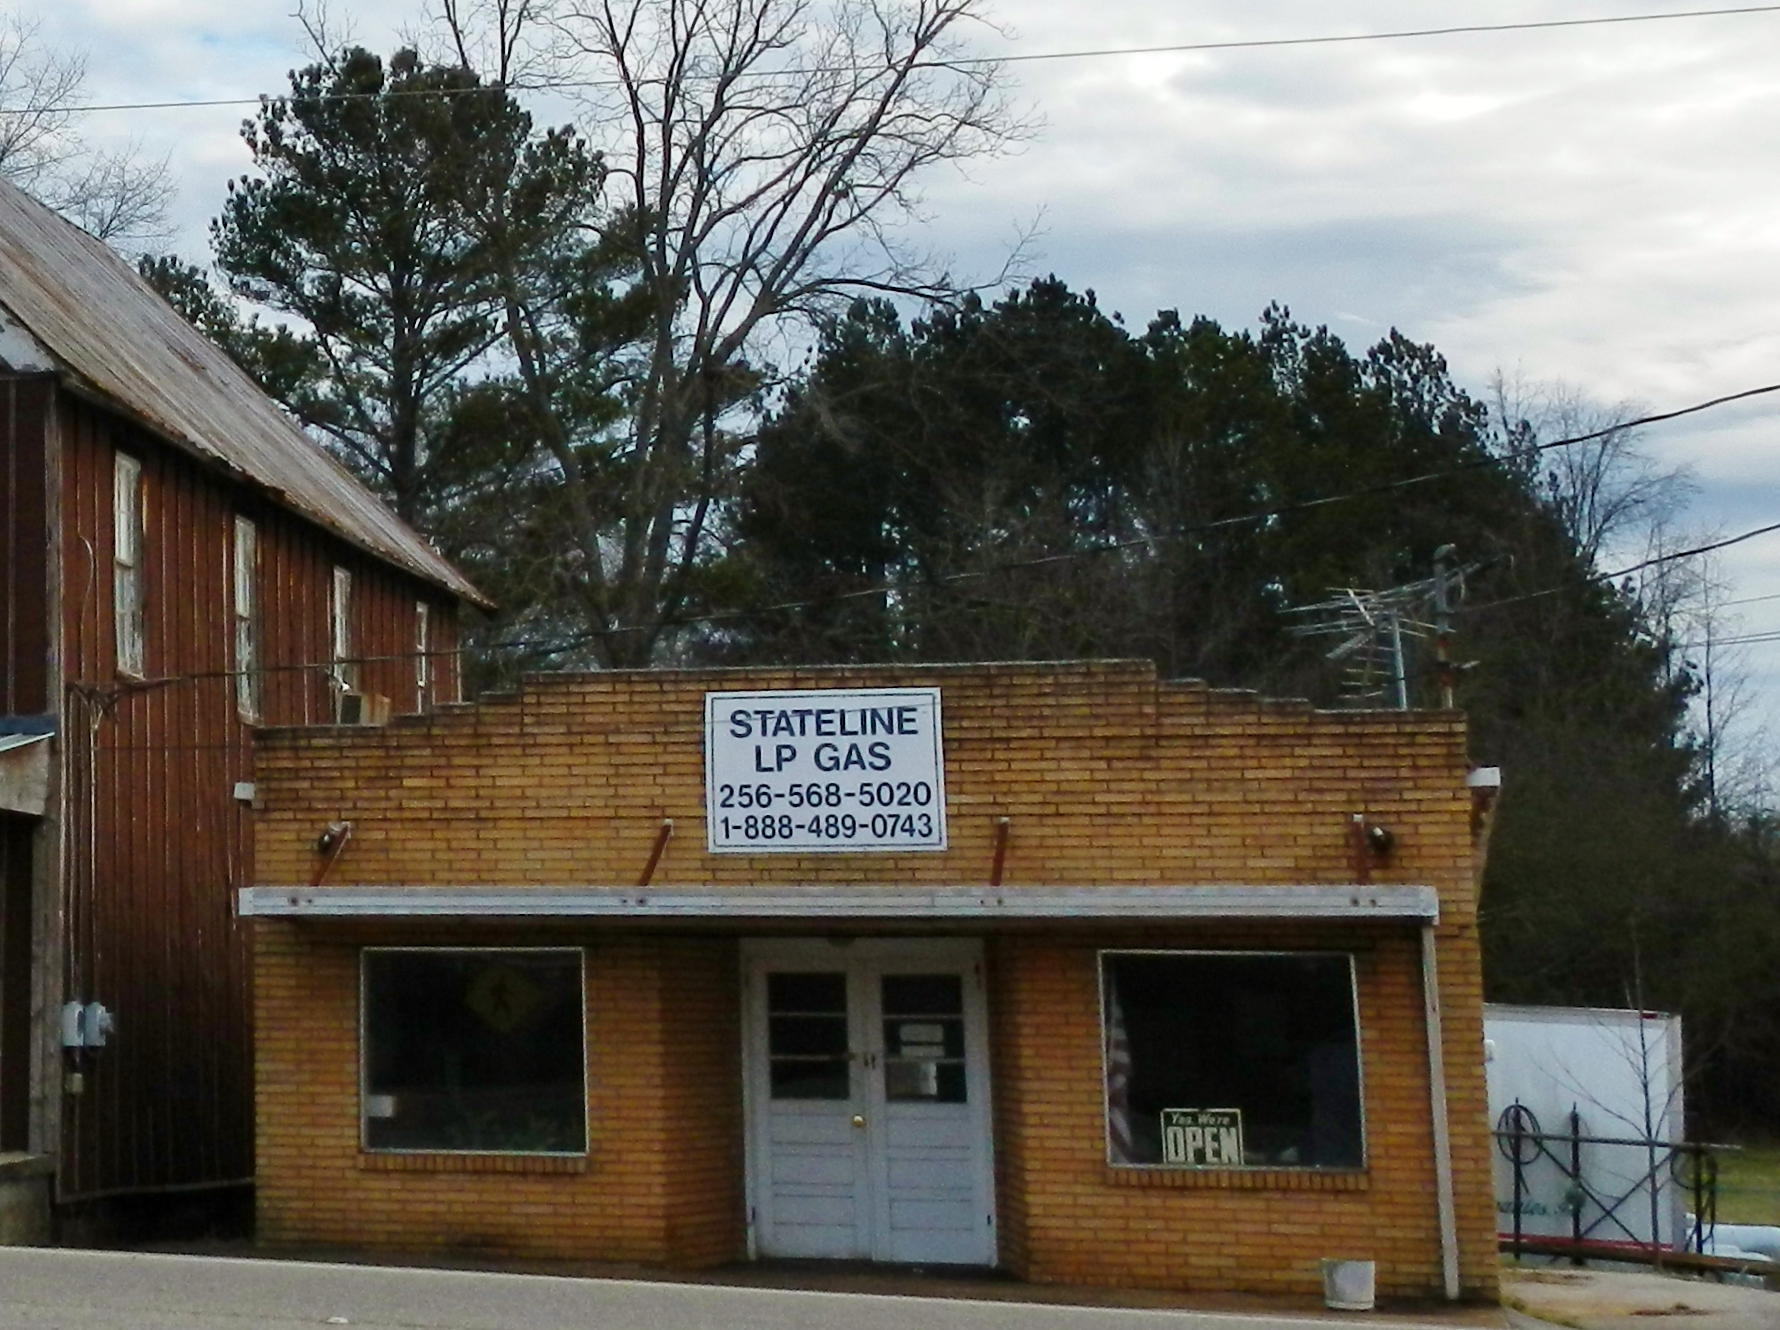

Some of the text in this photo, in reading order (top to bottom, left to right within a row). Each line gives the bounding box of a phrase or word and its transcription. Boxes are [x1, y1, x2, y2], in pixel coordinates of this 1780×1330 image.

[729, 707, 919, 738] STATELINE
[755, 742, 892, 773] LP GAS
[719, 781, 932, 808] 256-568-5020
[720, 813, 933, 839] 1-888-489-0743
[1166, 1126, 1239, 1164] OPEN
